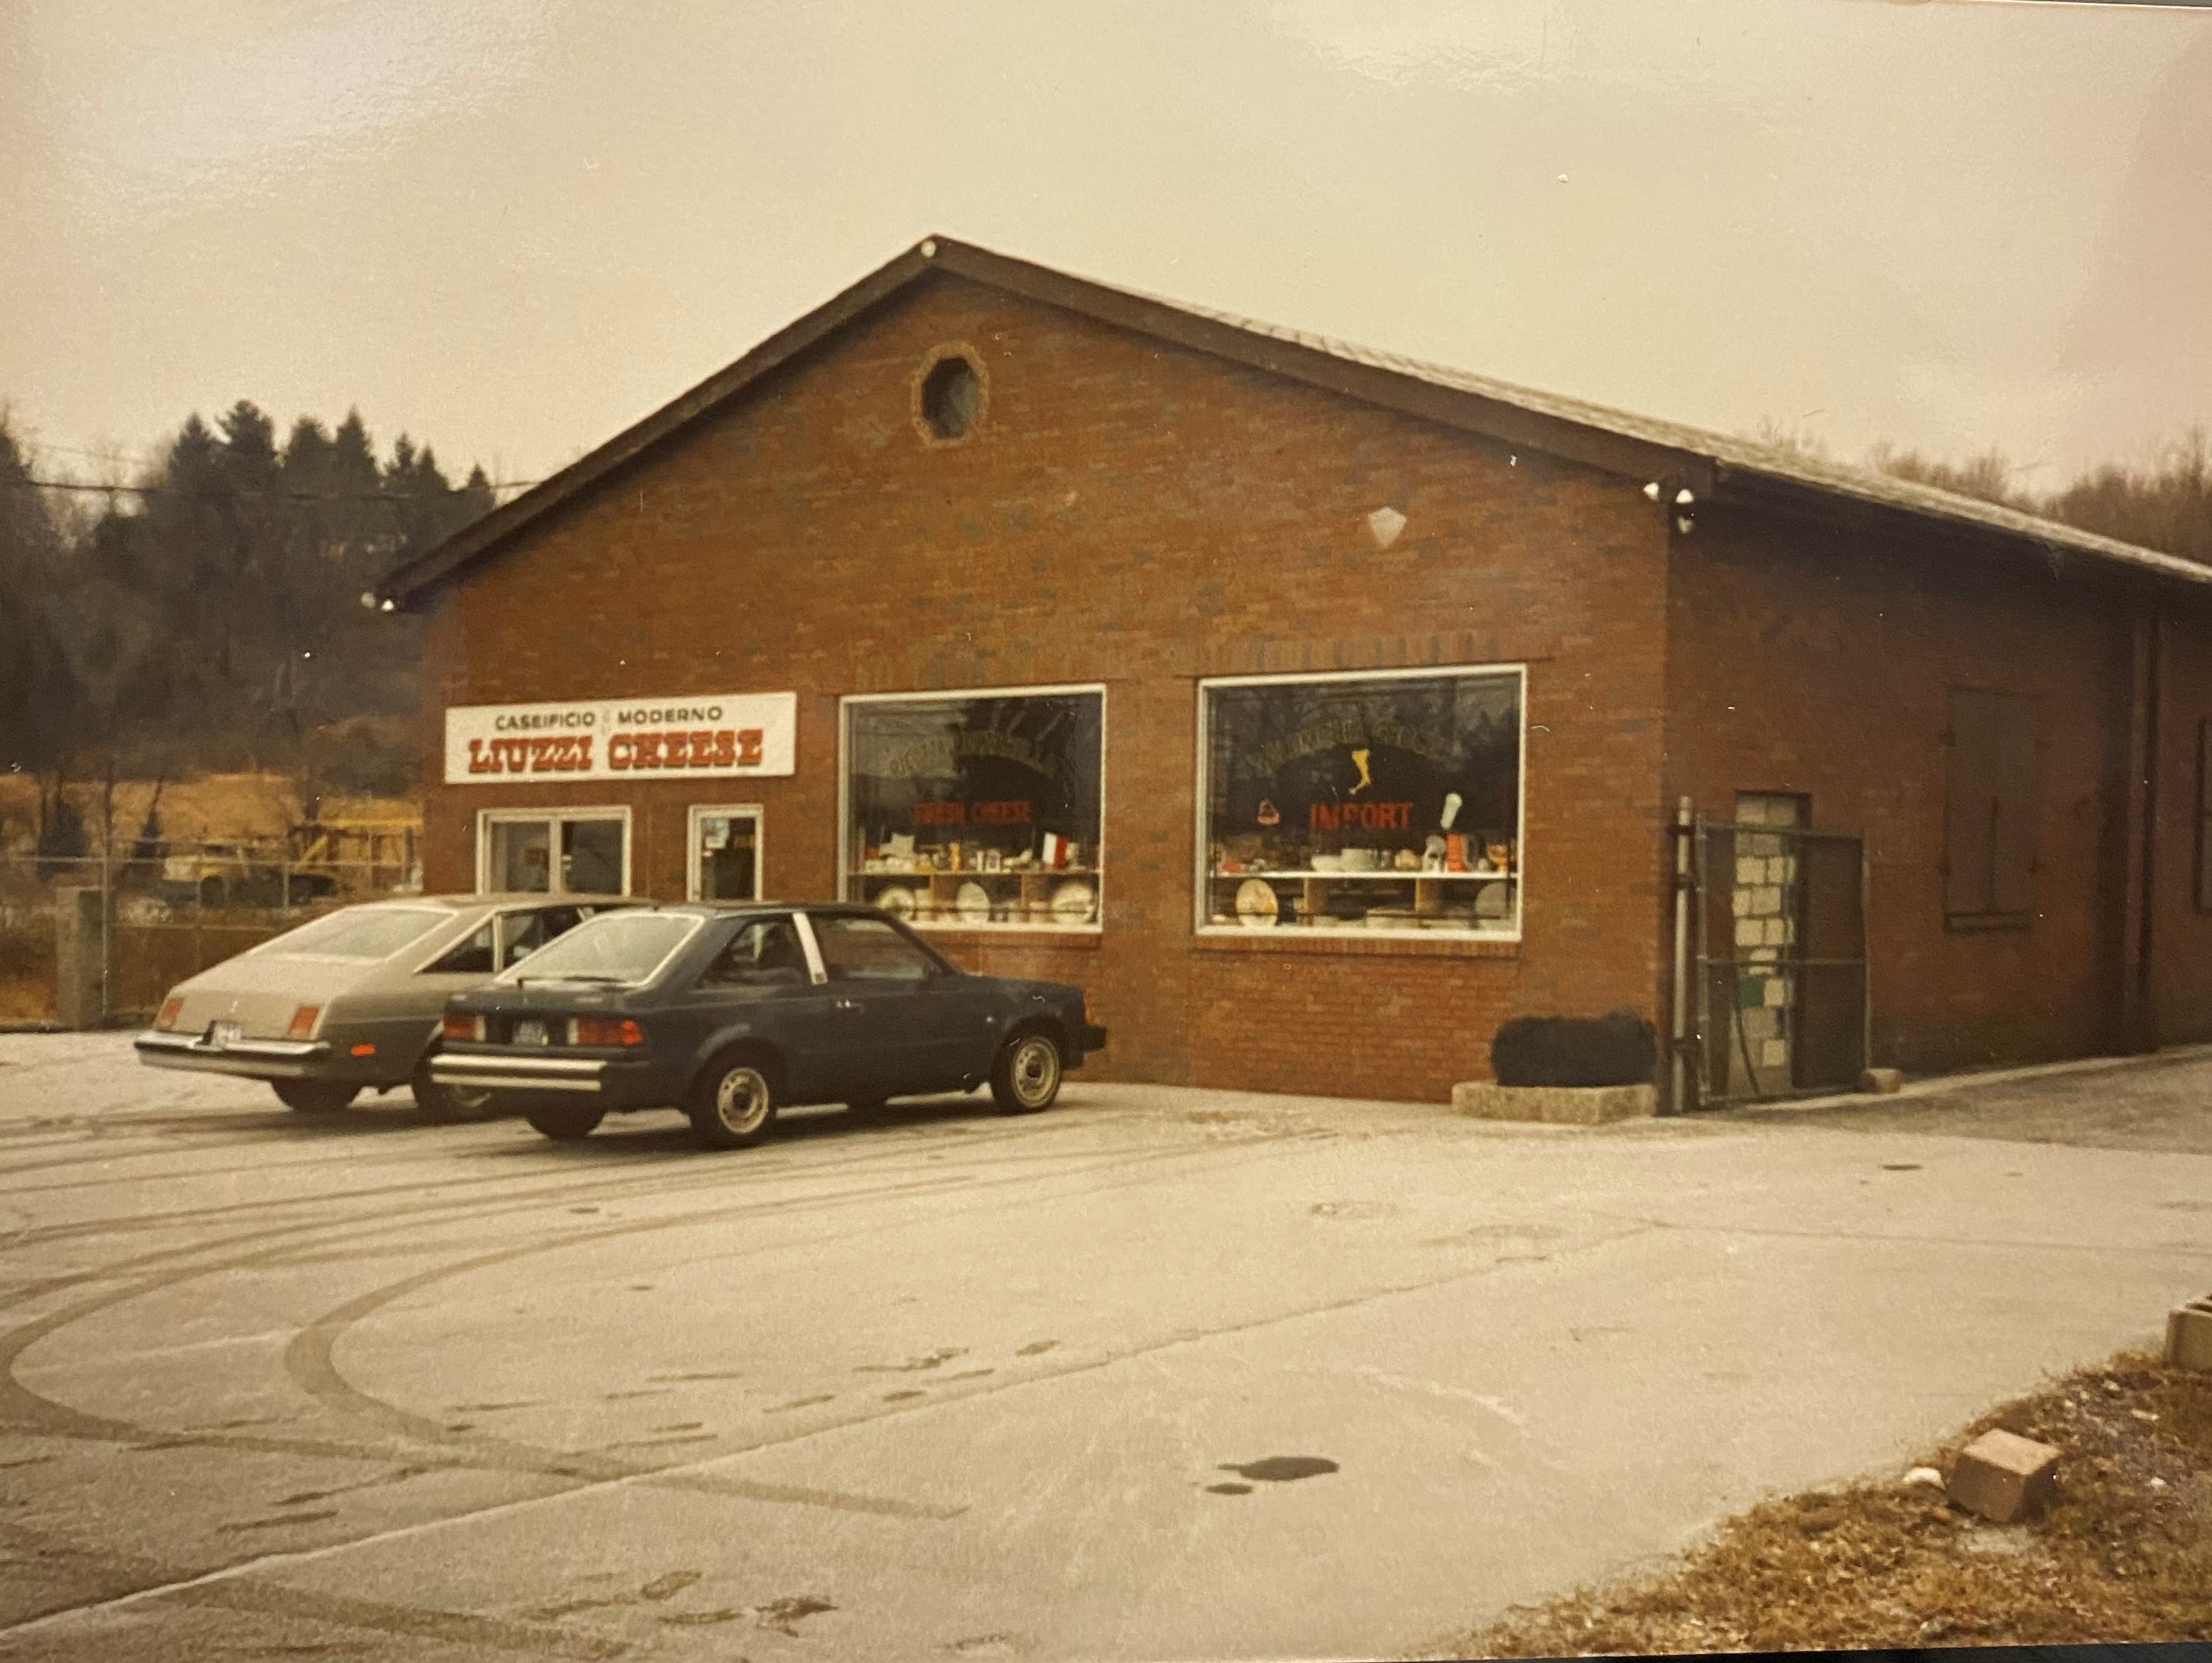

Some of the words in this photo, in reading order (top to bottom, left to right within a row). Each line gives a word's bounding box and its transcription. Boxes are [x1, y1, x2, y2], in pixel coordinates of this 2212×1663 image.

[495, 711, 595, 731] CASEIFICIO
[617, 706, 723, 725] MODERNO
[468, 735, 593, 773] LIUZZI
[608, 728, 764, 770] CHEESE
[1309, 802, 1413, 829] IMPORT
